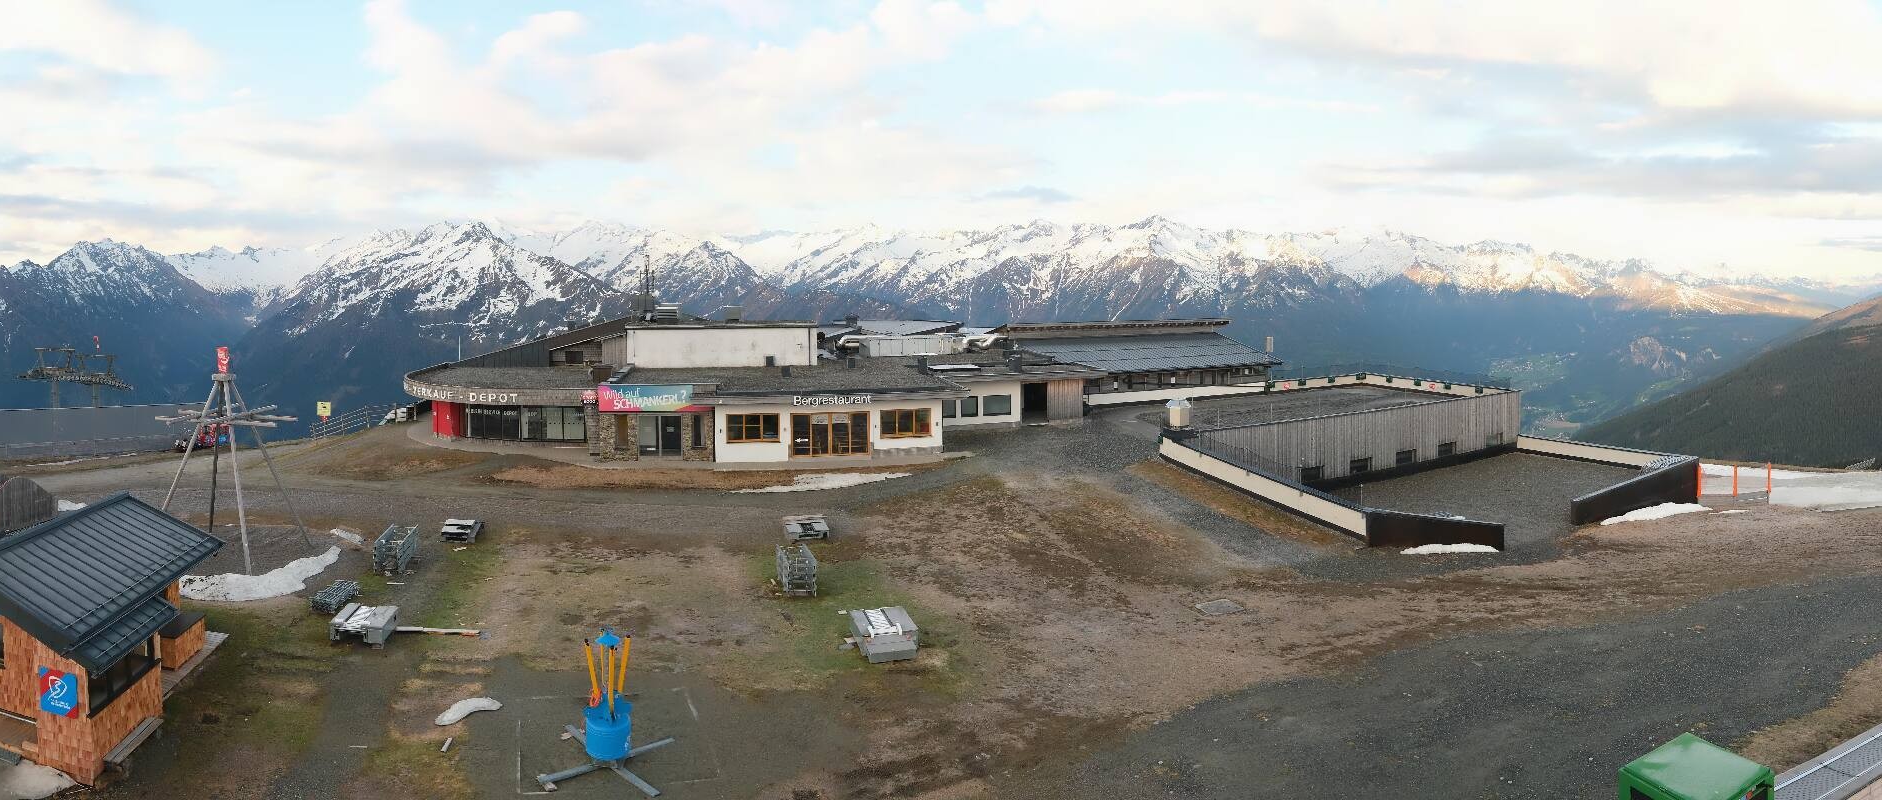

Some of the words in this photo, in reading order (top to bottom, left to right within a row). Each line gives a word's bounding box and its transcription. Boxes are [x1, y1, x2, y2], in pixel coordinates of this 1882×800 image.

[469, 392, 518, 403] DEPOT
[603, 390, 623, 400] Wild
[625, 387, 640, 398] auf
[793, 395, 872, 407] Bergrestaurant
